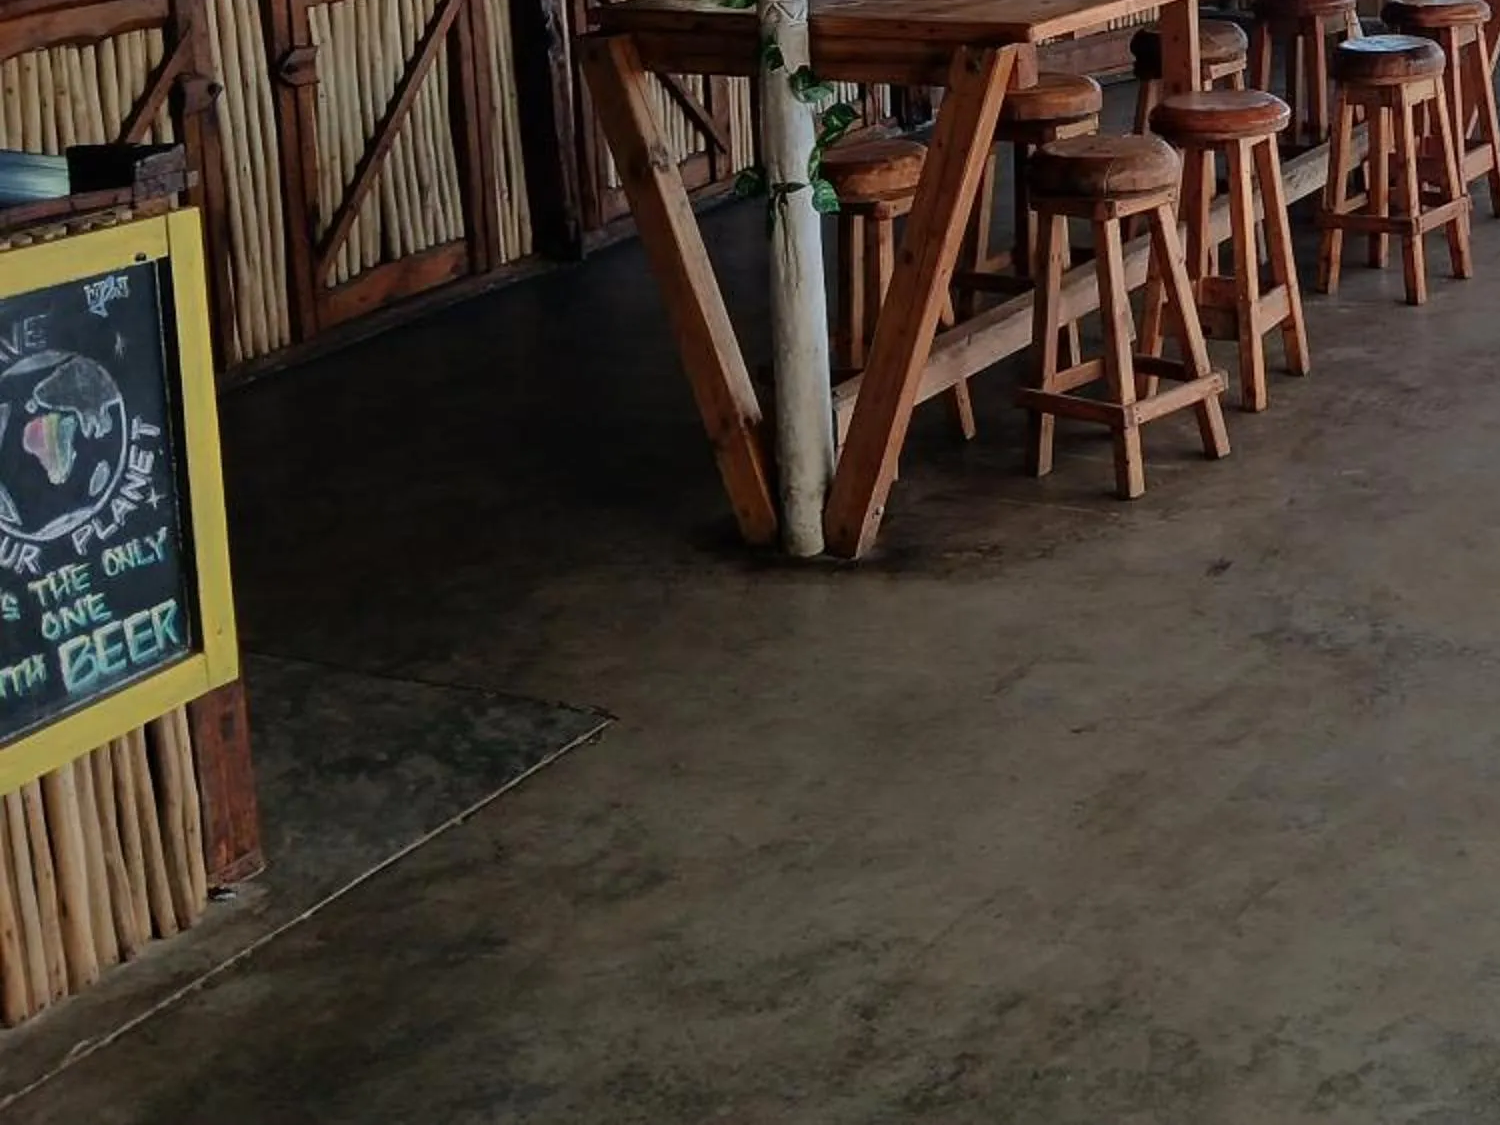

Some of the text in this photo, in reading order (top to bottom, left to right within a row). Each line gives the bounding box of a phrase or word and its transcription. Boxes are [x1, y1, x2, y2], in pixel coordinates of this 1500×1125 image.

[71, 415, 161, 557] PLANET
[28, 562, 93, 608] THE
[102, 526, 168, 577] ONLY
[41, 592, 113, 642] ONE
[57, 597, 182, 698] BEER
